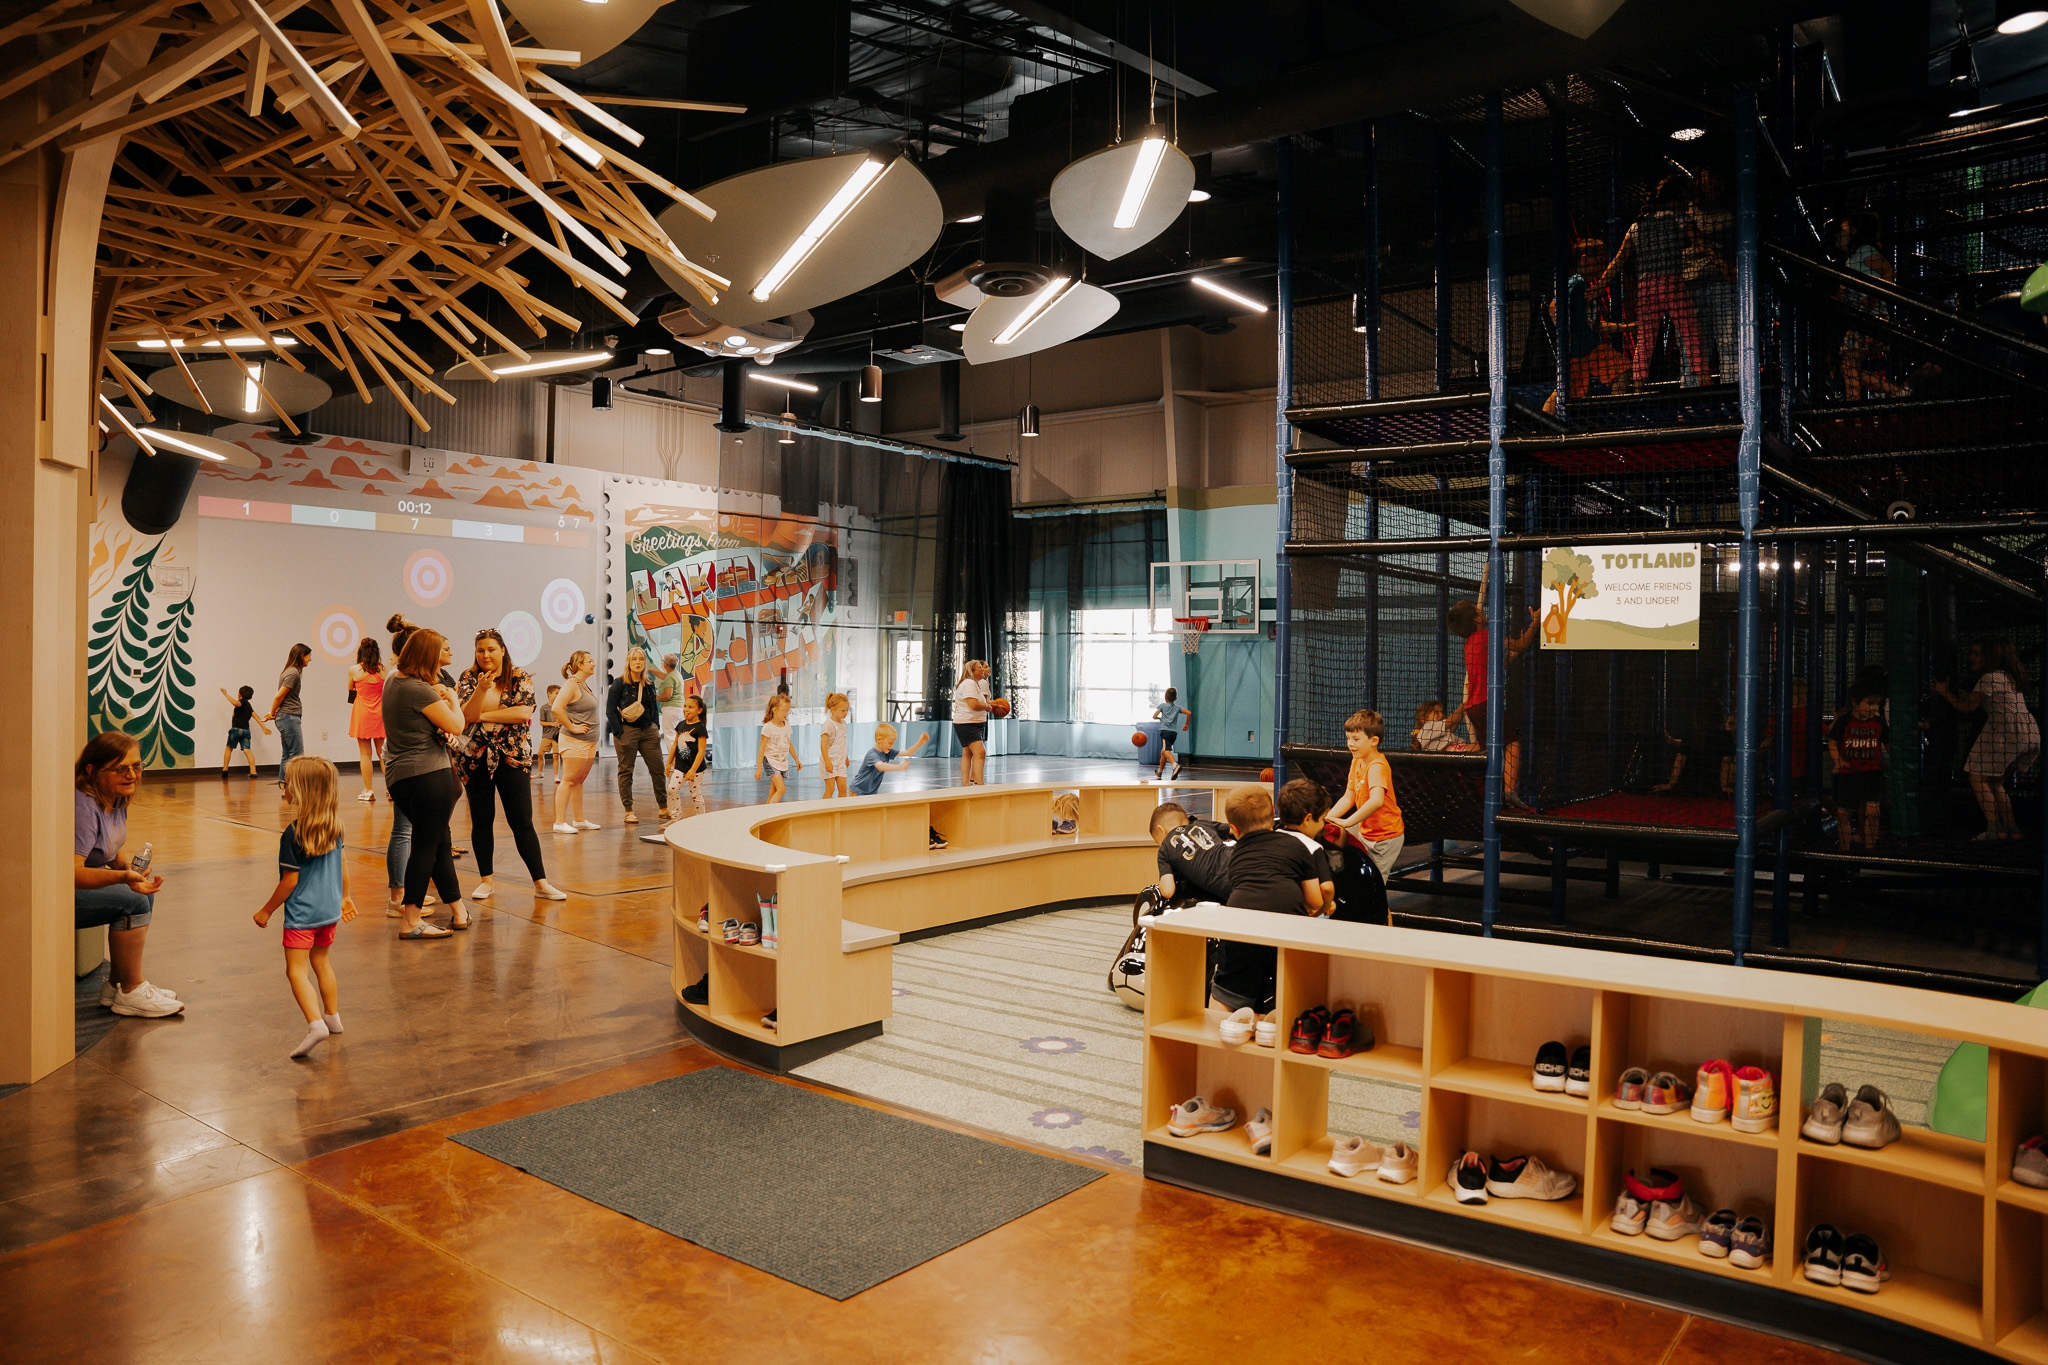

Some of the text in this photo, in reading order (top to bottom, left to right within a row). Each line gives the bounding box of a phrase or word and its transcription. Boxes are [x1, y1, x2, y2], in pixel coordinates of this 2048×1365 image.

[397, 500, 432, 515] 00:12
[242, 502, 560, 542] 1 0 7 3 1
[573, 518, 581, 529] 7
[630, 531, 741, 556] Greetings From
[1601, 552, 1696, 569] TOTLAND
[1604, 582, 1693, 591] WELCOME FRIENDS
[1616, 595, 1680, 605] 3 AND UNDER!
[680, 581, 826, 683] PARK
[1169, 825, 1215, 861] 30
